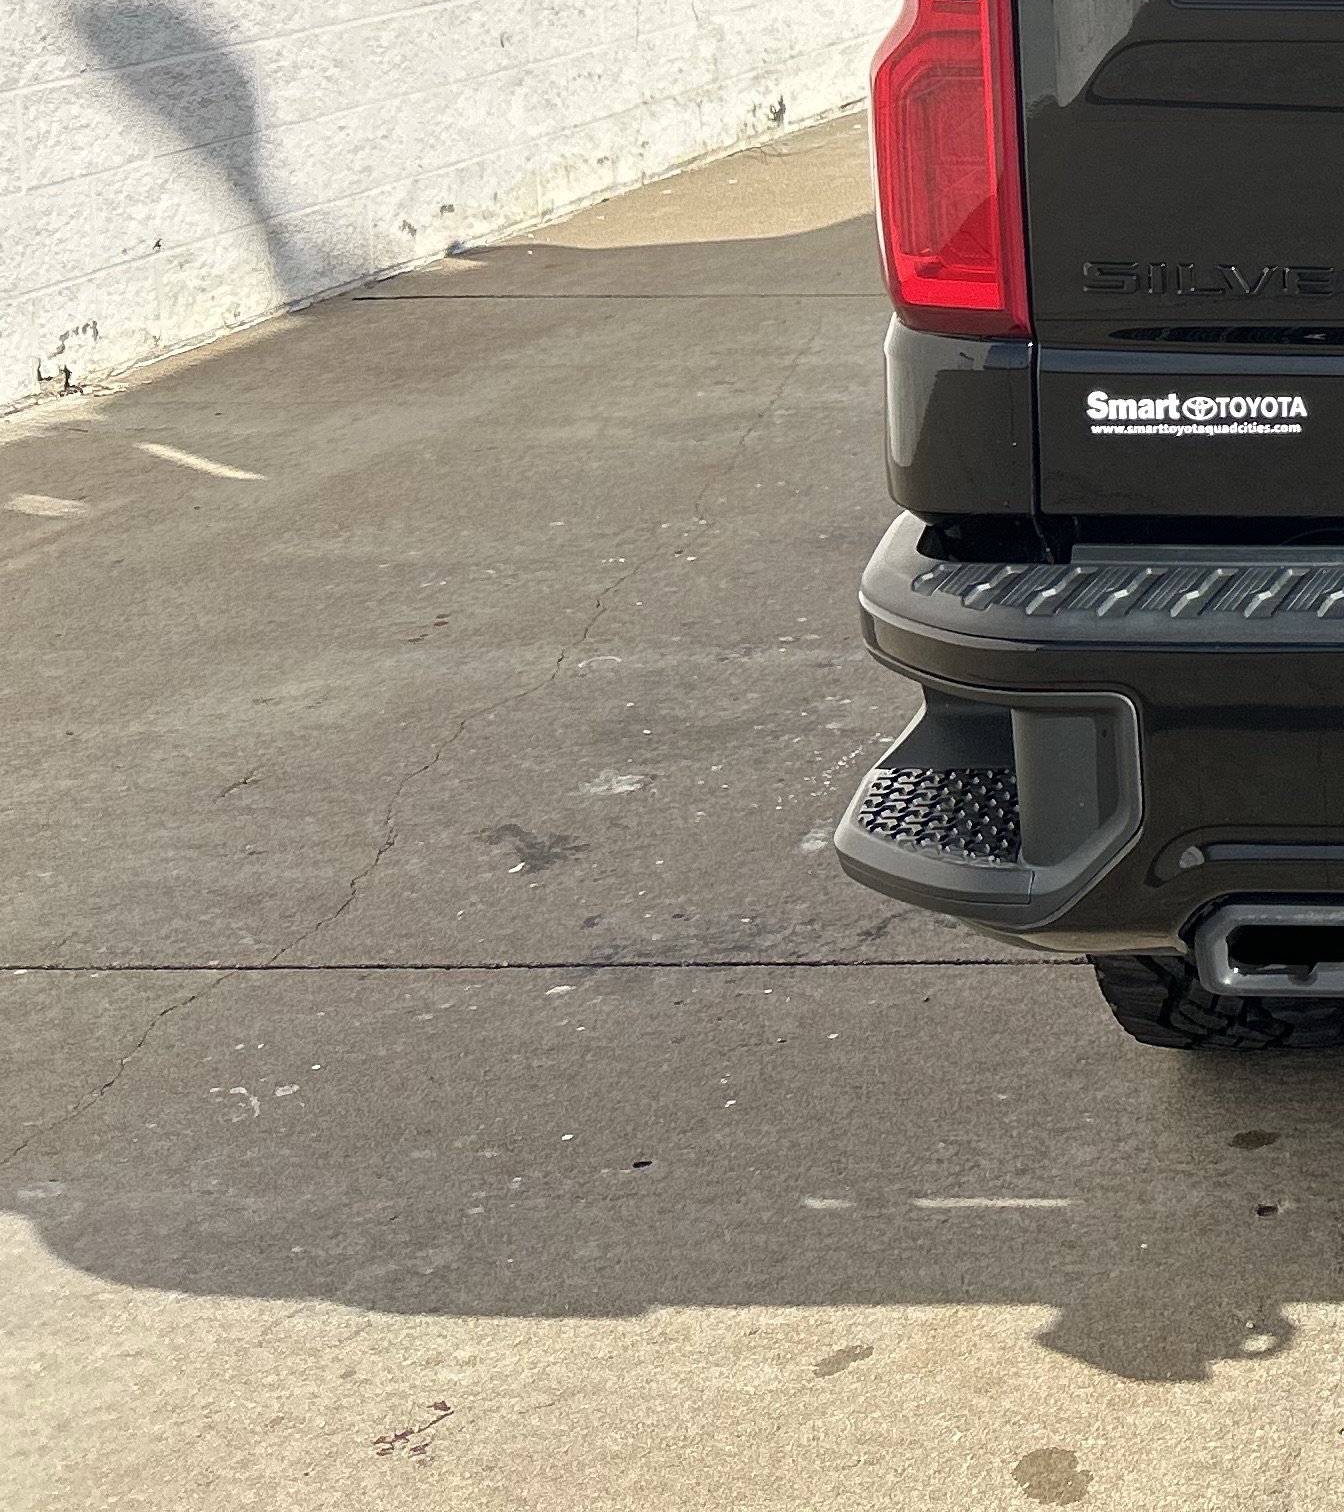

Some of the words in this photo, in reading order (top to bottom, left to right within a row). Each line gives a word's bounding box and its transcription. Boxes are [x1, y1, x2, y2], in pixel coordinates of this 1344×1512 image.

[1086, 390, 1181, 420] Smart
[1216, 396, 1308, 419] TOYOTA
[1090, 421, 1302, 436] www.smarttoyotaquadcities.com
